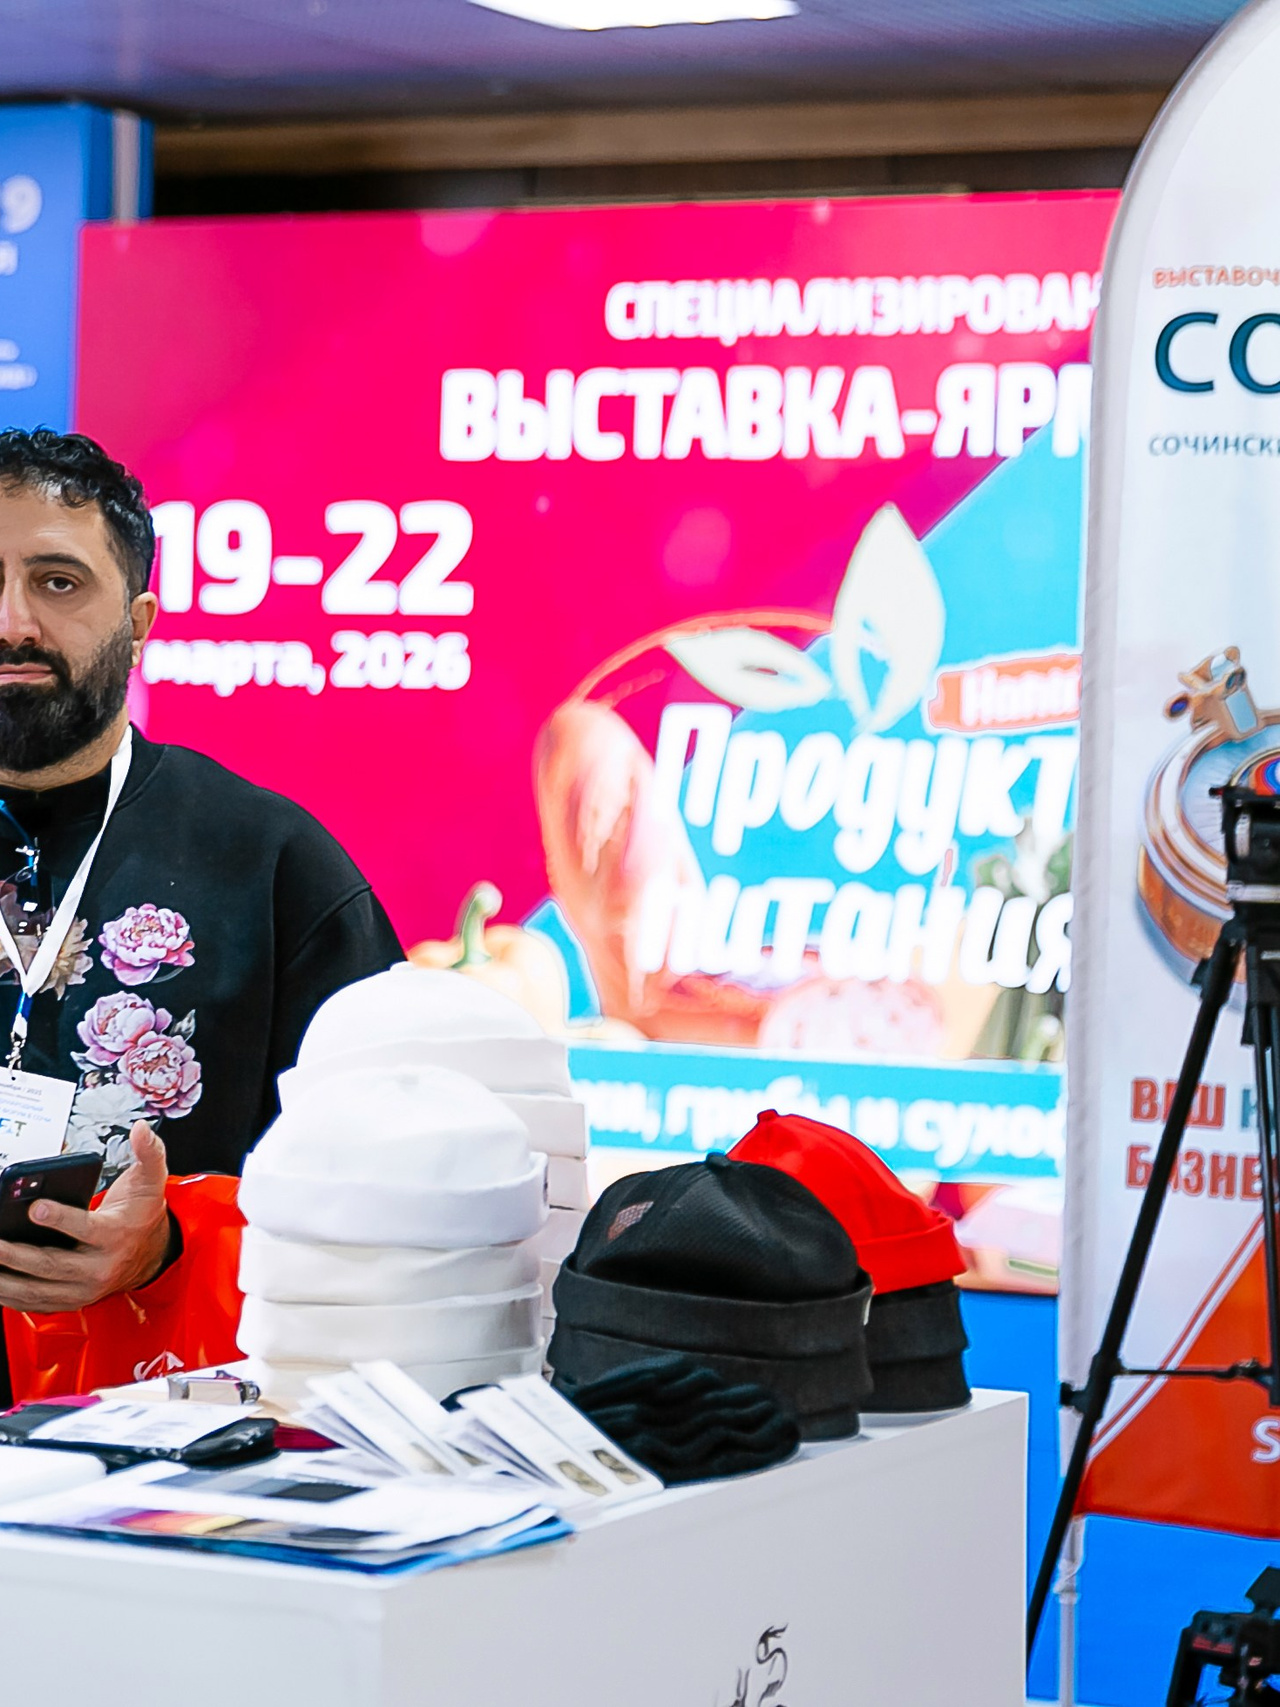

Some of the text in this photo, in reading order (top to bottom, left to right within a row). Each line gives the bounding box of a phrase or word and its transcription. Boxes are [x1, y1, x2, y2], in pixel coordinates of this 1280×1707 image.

[150, 499, 474, 615] 19-22
[142, 630, 471, 698] марта, 2026
[1126, 1144, 1280, 1201] БЗНЕ
